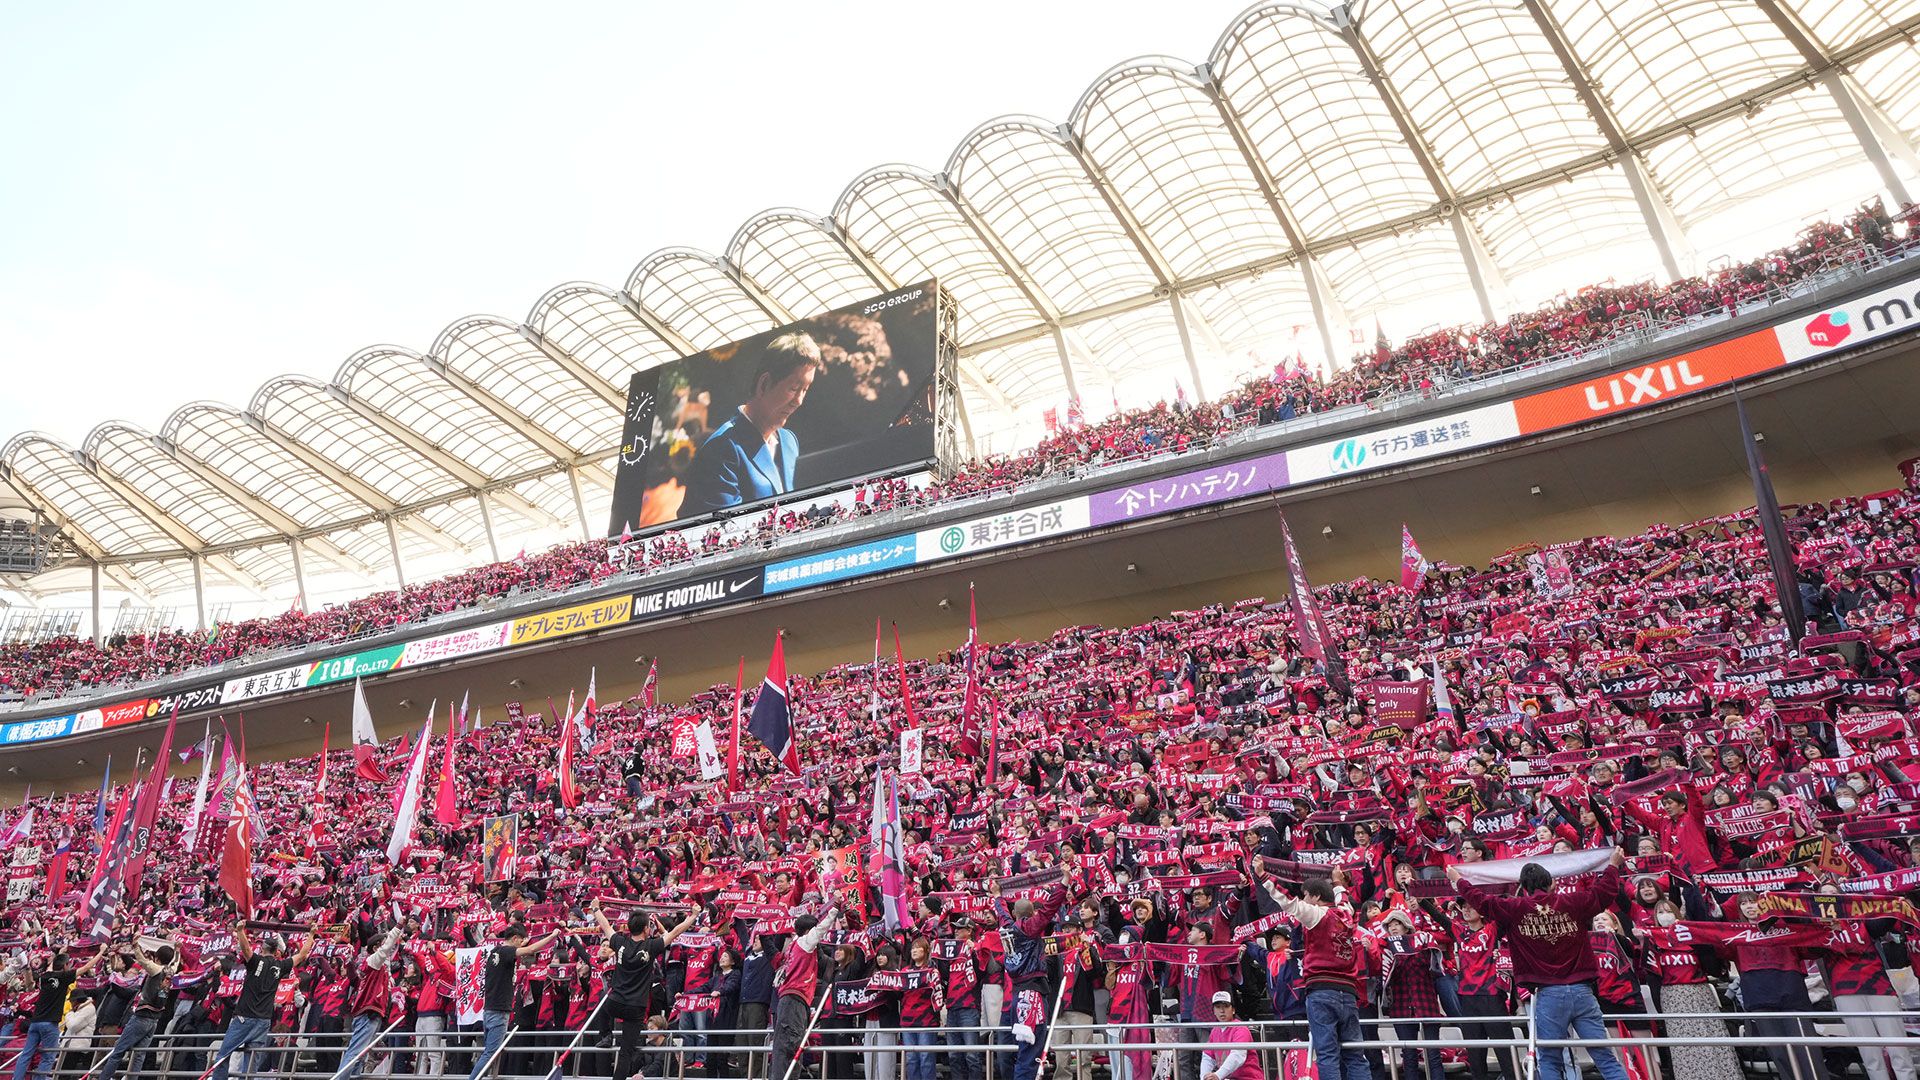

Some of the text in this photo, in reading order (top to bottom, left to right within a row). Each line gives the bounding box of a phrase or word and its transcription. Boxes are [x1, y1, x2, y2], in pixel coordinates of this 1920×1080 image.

[888, 289, 922, 309] GROUP
[1863, 292, 1920, 332] m
[1585, 361, 1704, 411] LIXIL
[1371, 425, 1450, 457] 行方運送
[1452, 430, 1471, 440] 会社
[622, 444, 632, 453] 45
[1149, 466, 1256, 503] トノハテクノ
[969, 506, 1062, 546] 東洋合成
[1805, 536, 1844, 549] ANTLERS
[766, 545, 915, 584] 茨城県薬剤師会検査センター
[635, 580, 725, 616] NIKE FOOTBALL
[515, 600, 629, 639] ザ・プレミアム・モルツ
[241, 670, 300, 698] 東京互光
[1601, 677, 1661, 694] レオセアラ
[1713, 685, 1725, 695] 27
[1378, 686, 1419, 695] Winning
[1379, 700, 1399, 709] only
[674, 719, 696, 756] 全勝
[1910, 743, 1919, 755] 6
[1835, 761, 1849, 773] 10
[1507, 775, 1545, 786] KASHIMA
[1226, 794, 1240, 804] KEI
[1252, 797, 1262, 809] 13
[1199, 823, 1209, 833] 22
[1899, 823, 1908, 834] 2
[1210, 845, 1217, 856] 2
[1086, 857, 1095, 867] 10
[1154, 852, 1163, 863] 14
[1702, 867, 1798, 884] ASHIMA ANTLERS
[1127, 883, 1140, 893] 32
[1189, 878, 1200, 887] 40
[1755, 881, 1785, 892] DREAM
[1020, 889, 1029, 900] 13
[960, 899, 969, 911] 71
[1820, 902, 1837, 920] 14
[1259, 921, 1268, 932] 40
[1674, 924, 1693, 942] 40
[836, 935, 842, 944] 2
[945, 946, 954, 958] 12
[1044, 943, 1057, 955] 40
[1395, 941, 1404, 953] 6
[1187, 953, 1198, 963] 12
[1660, 953, 1697, 966] LIXIL
[908, 979, 918, 989] 14
